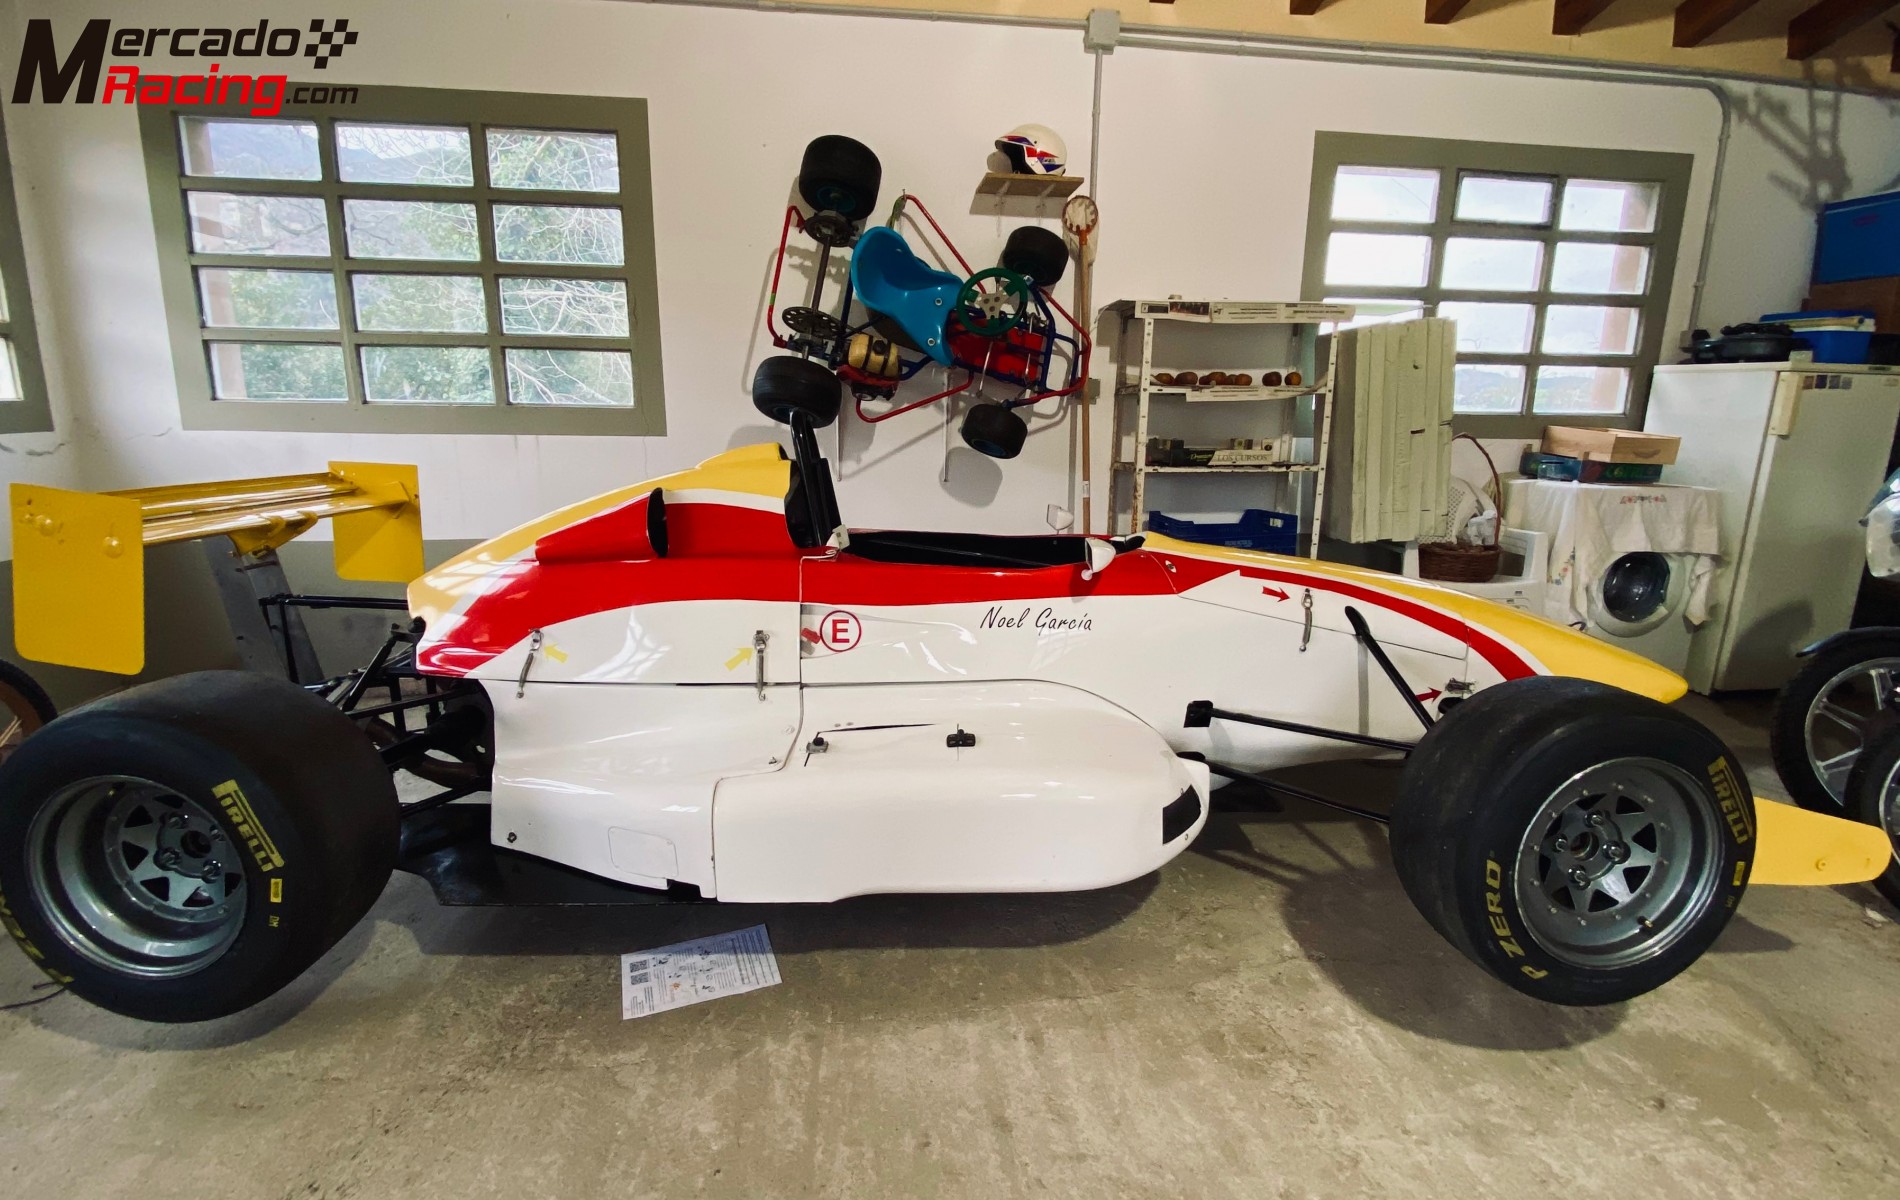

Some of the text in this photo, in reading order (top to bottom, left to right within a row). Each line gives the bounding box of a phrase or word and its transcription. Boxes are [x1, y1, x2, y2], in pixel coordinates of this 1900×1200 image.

[830, 618, 850, 644] E
[980, 605, 1093, 636] Noel García
[211, 779, 285, 872] PIRELLI
[1707, 755, 1753, 844] PIRELLI
[1486, 859, 1549, 980] P ZERO
